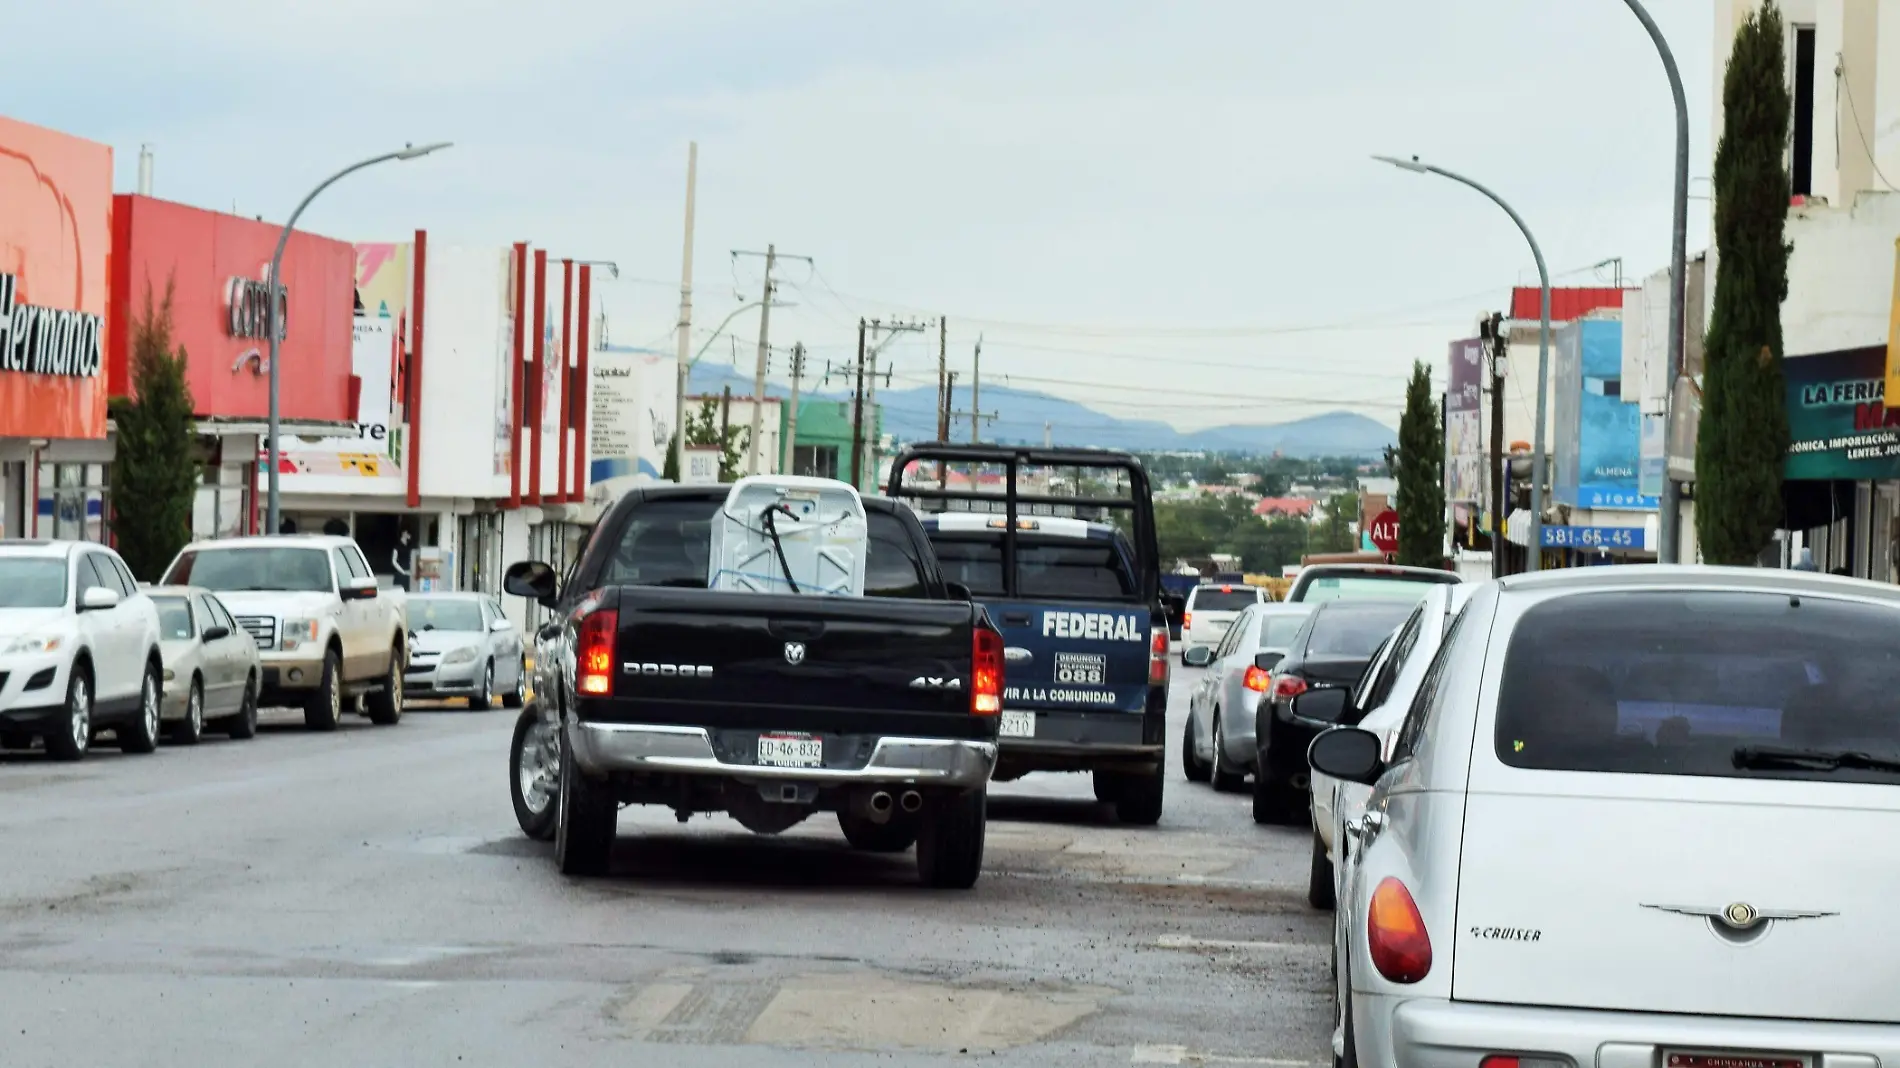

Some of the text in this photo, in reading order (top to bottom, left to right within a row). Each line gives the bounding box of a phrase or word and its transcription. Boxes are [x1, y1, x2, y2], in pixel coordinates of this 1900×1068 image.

[0, 272, 104, 378] Hermanos
[1803, 379, 1885, 406] LA FERIA
[352, 422, 387, 440] re
[1043, 611, 1142, 641] FEDERAL
[1059, 654, 1102, 664] DENUNCIA
[623, 662, 714, 678] DODGE
[1059, 669, 1101, 683] 088
[1023, 688, 1030, 700] A
[1033, 688, 1047, 701] LA
[1050, 689, 1116, 704] COMUNIDAD
[760, 741, 820, 757] ED-46-832
[1482, 927, 1542, 942] CRUISER
